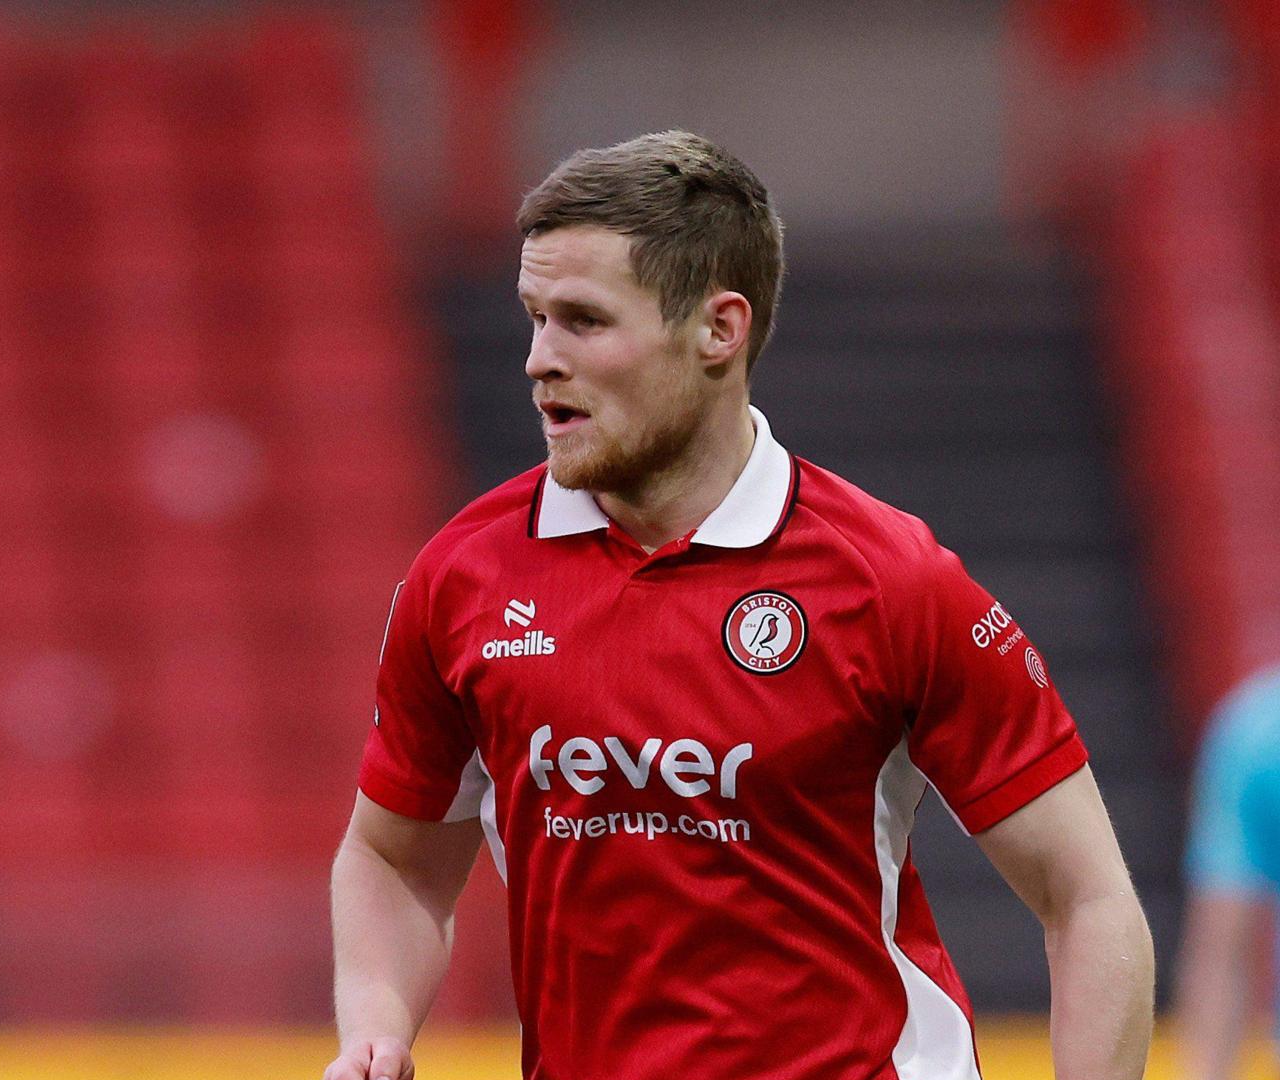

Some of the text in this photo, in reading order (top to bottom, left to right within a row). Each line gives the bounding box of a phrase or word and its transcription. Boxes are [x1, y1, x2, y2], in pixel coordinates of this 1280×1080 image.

[741, 597, 793, 615] BRISTOL
[748, 656, 780, 668] CITY
[529, 724, 753, 799] fever
[544, 806, 751, 842] feverup.com
